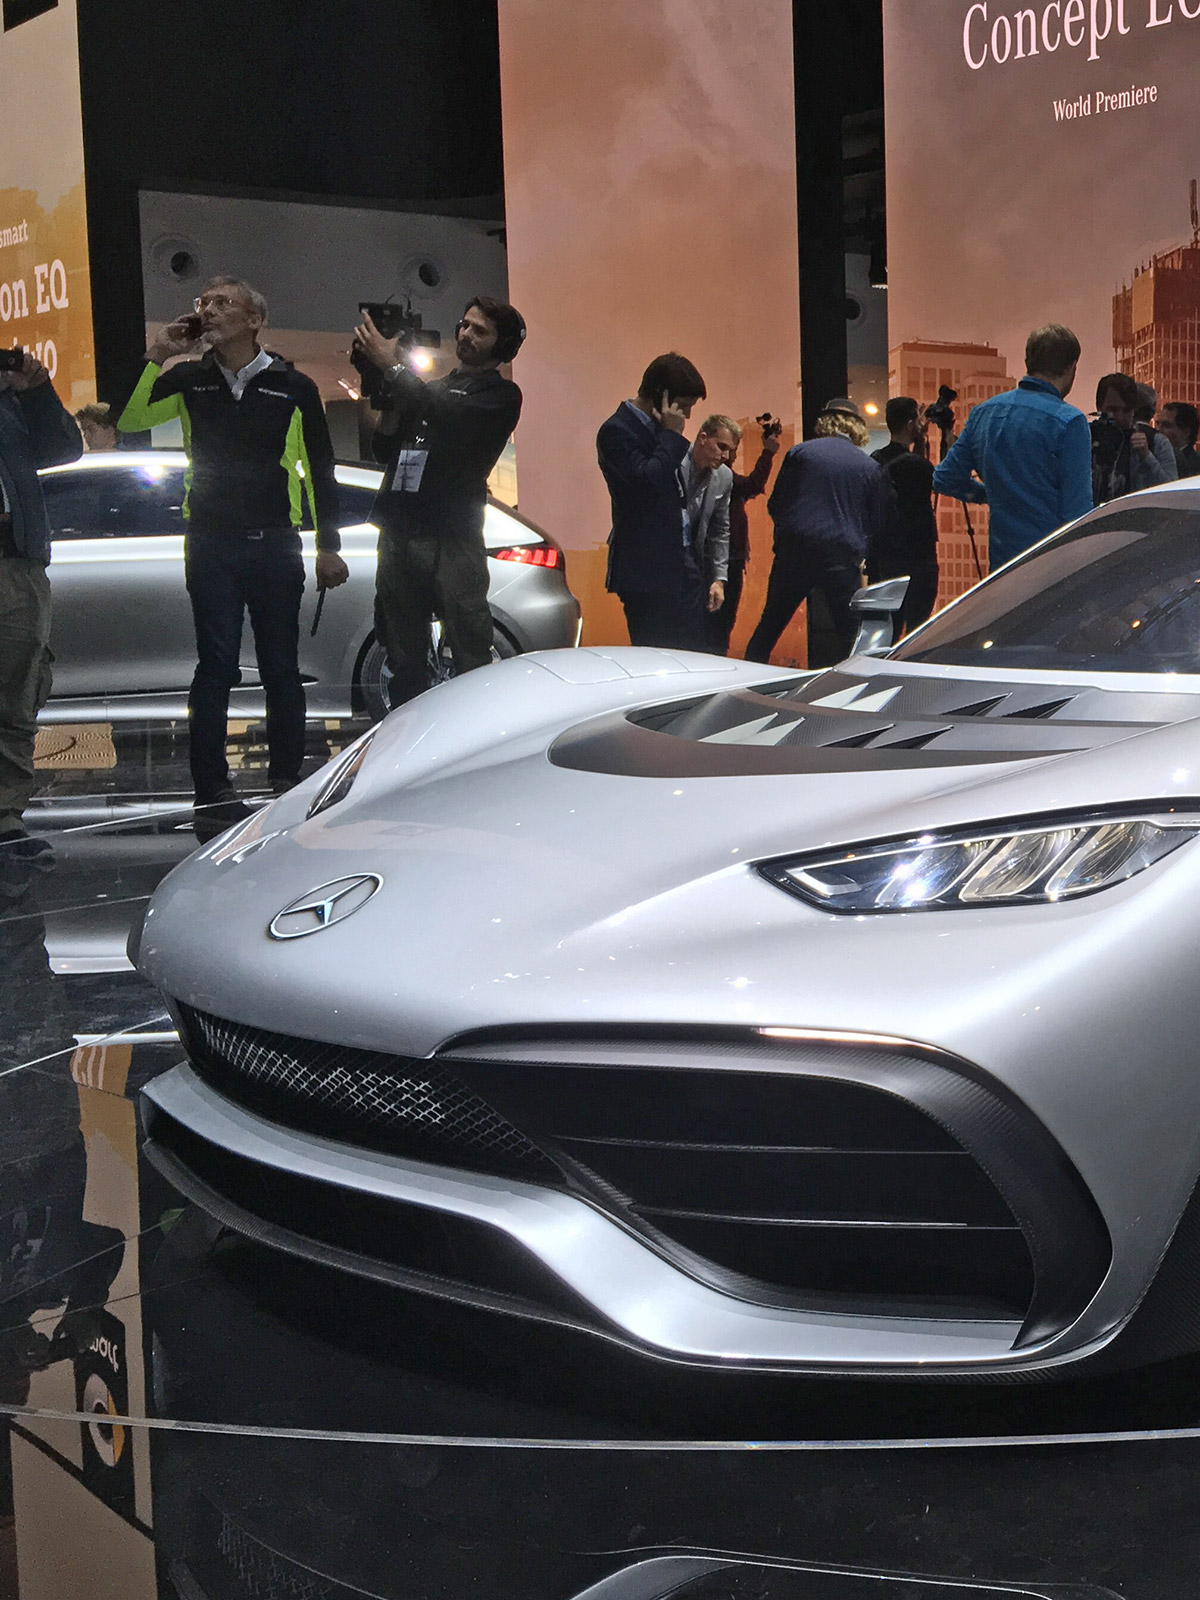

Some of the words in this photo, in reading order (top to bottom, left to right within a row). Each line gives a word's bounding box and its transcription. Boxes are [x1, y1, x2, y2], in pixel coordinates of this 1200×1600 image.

[963, 0, 1130, 69] Concept
[1053, 94, 1092, 122] World
[1095, 84, 1158, 114] Premiere
[34, 258, 69, 315] EQ
